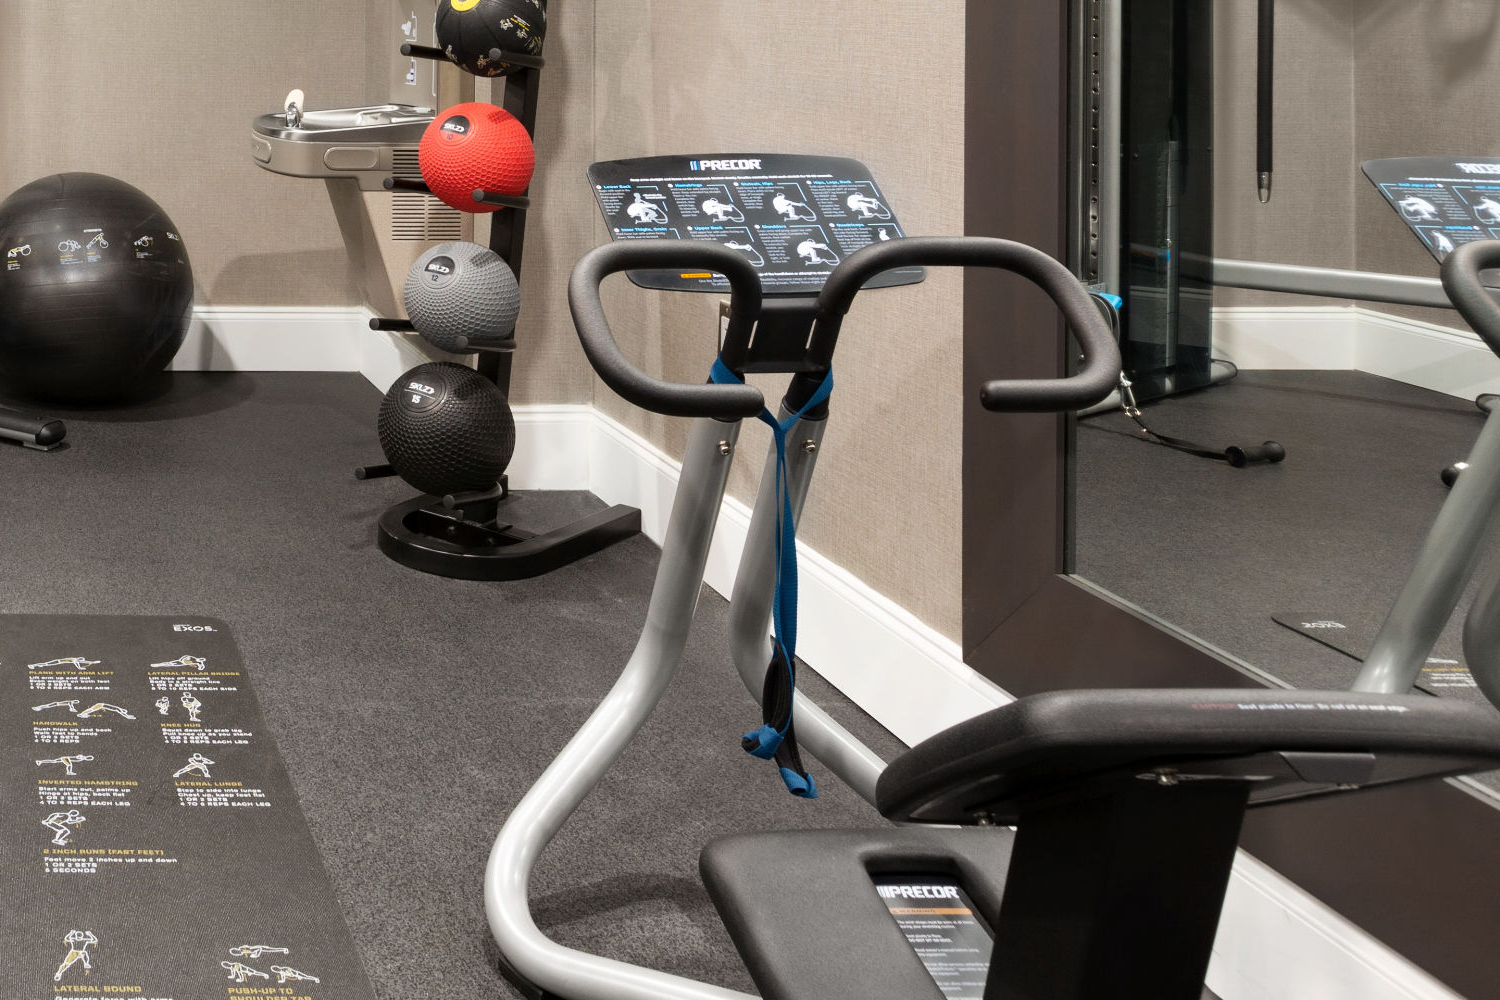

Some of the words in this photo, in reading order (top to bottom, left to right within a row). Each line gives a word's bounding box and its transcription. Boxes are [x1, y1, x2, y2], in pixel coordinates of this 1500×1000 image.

[444, 122, 461, 132] SKLZ
[700, 160, 762, 170] PRECOR
[429, 264, 446, 273] SKLZ
[409, 382, 428, 393] SKLZ
[412, 395, 420, 404] 15
[890, 886, 960, 898] PRECOR
